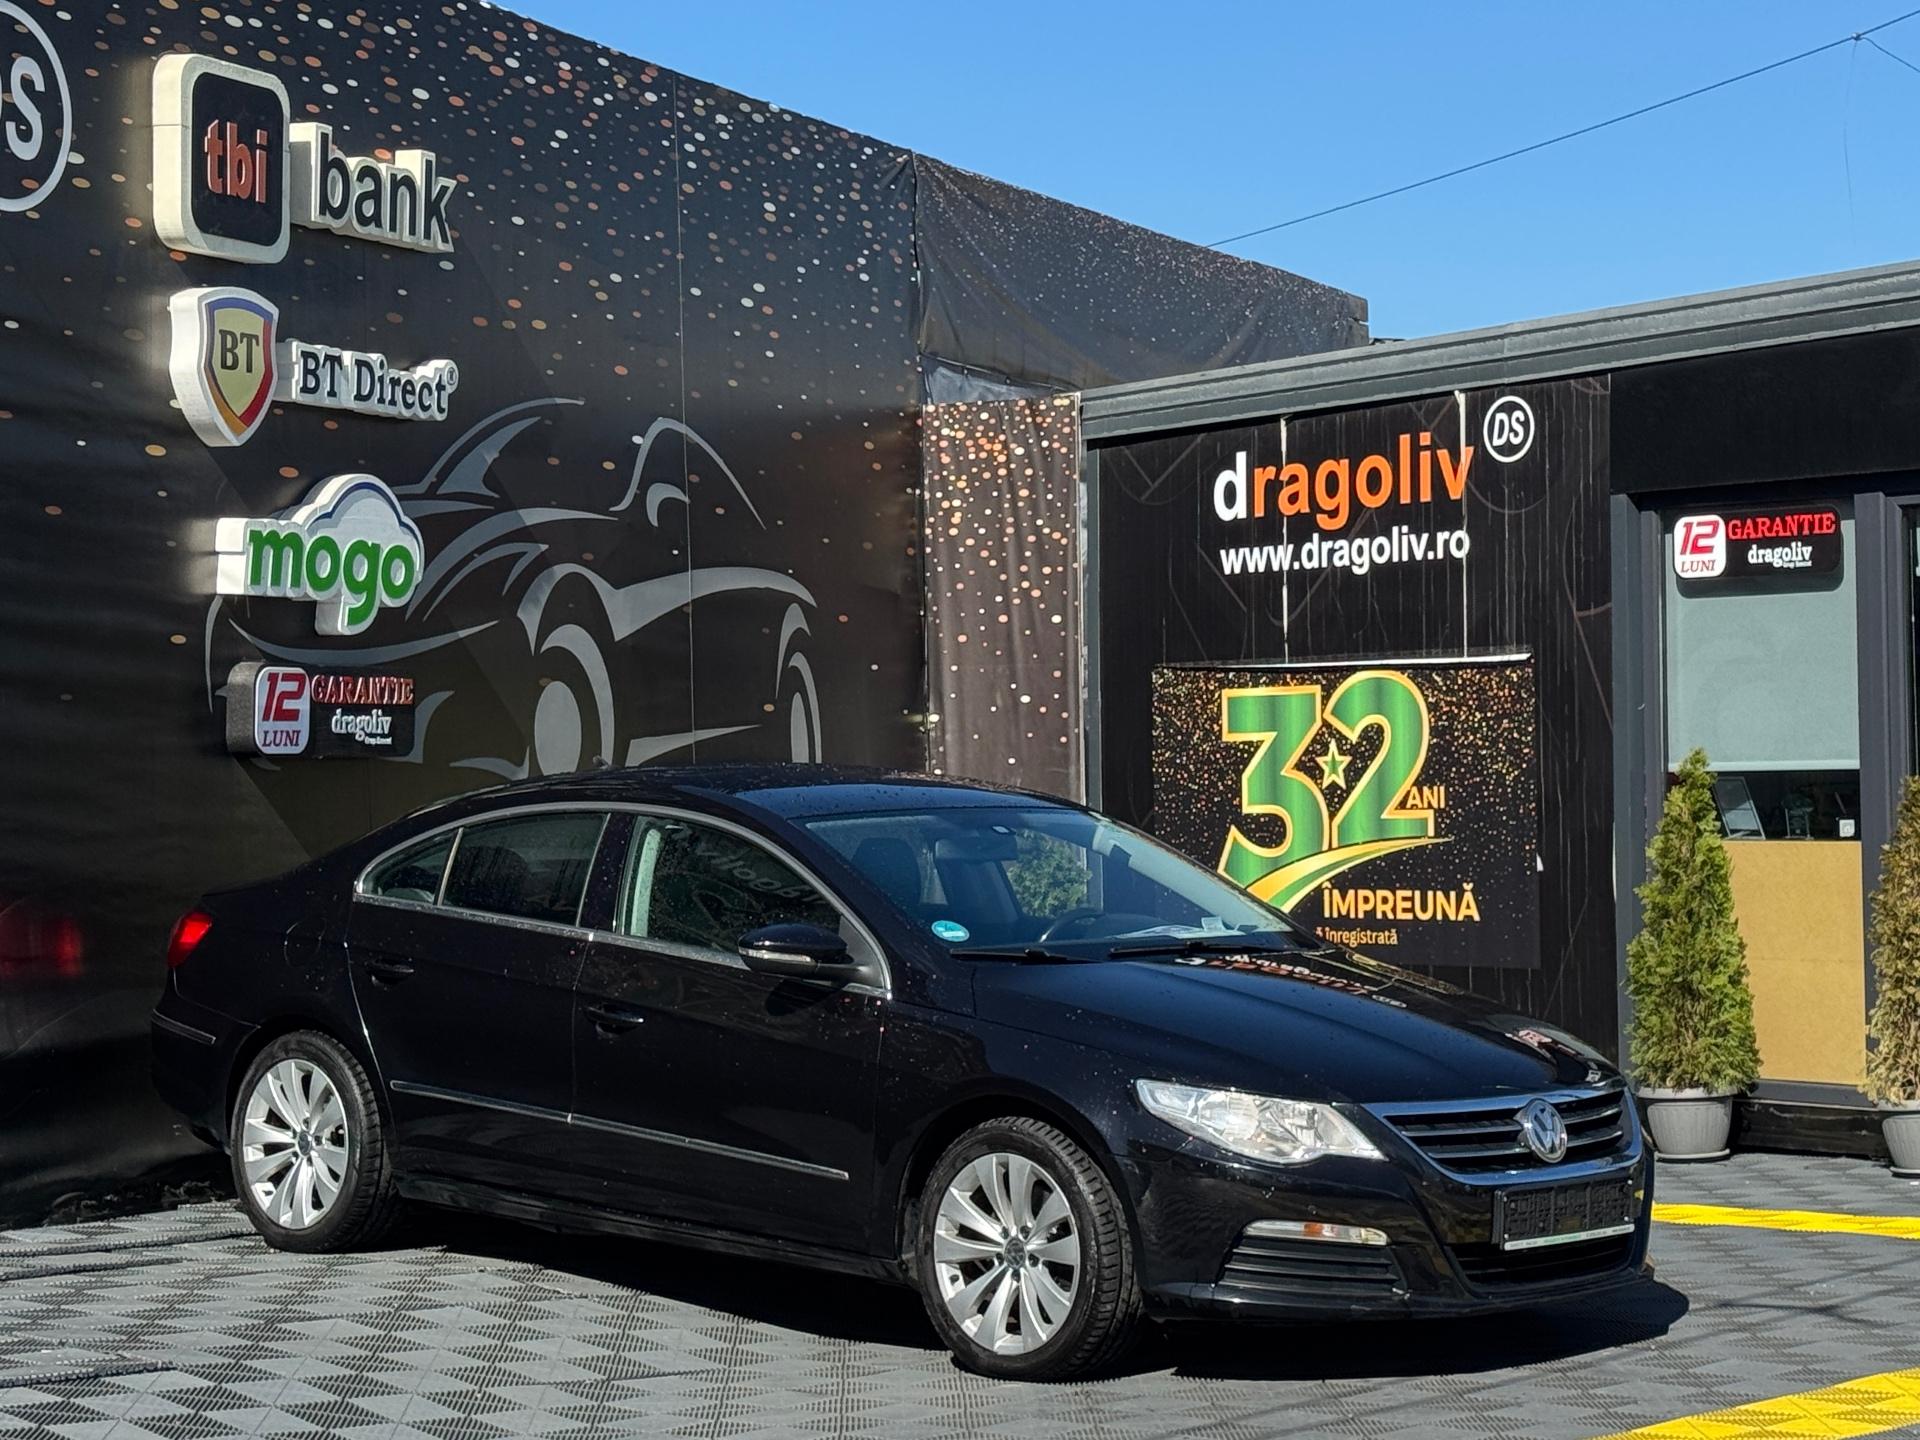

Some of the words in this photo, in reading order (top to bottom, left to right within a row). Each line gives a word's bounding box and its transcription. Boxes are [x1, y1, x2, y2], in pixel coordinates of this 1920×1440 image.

[0, 56, 45, 161] S
[204, 119, 268, 204] tbi
[319, 131, 456, 245] bank
[219, 328, 260, 374] BT
[301, 350, 343, 398] BT
[1492, 410, 1526, 447] DS
[1213, 431, 1475, 530] dragoliv
[1680, 520, 1719, 555] 12
[1727, 512, 1837, 541] GARANTIE
[1220, 526, 1471, 576] www.dragoliv.ro
[1680, 559, 1716, 573] LUNI
[1747, 541, 1813, 568] dragoliv
[248, 528, 416, 625] mogo
[262, 672, 306, 722] 12
[311, 674, 414, 705] GARANTIE
[262, 729, 301, 748] LUNI
[331, 708, 392, 742] dragoliv
[1217, 670, 1434, 890] 32
[1406, 786, 1446, 809] ANI
[1323, 880, 1480, 922] ÎMPREUNĂ
[1324, 926, 1398, 948] înregistrată
